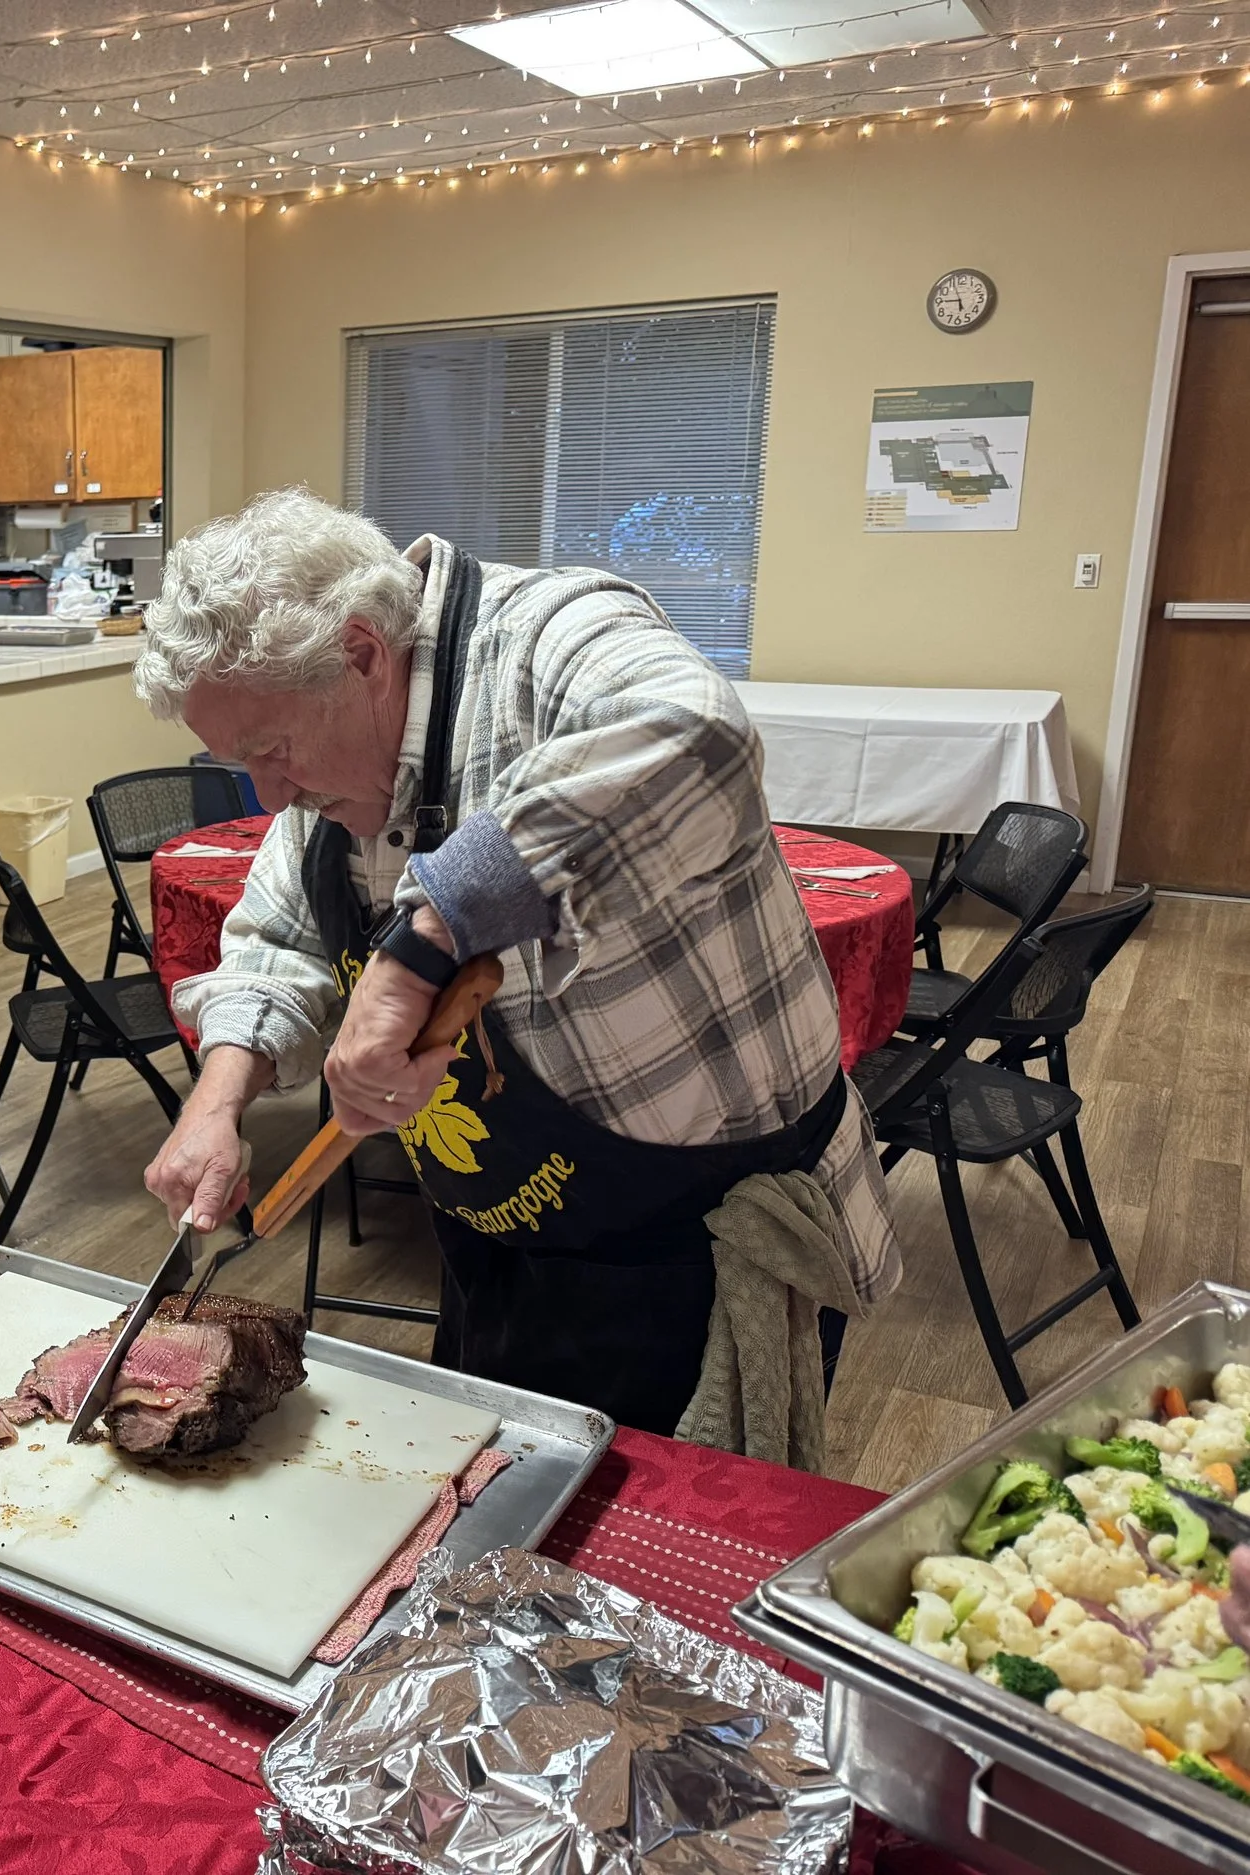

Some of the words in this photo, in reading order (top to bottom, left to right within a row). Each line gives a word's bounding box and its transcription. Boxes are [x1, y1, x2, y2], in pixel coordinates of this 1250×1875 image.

[974, 284, 982, 293] 2
[977, 294, 984, 303] 3
[938, 308, 945, 317] 8
[972, 305, 979, 314] 4
[947, 315, 953, 324] 7
[954, 316, 962, 325] 6
[964, 313, 971, 323] 5
[456, 1152, 575, 1234] Bourgogne
